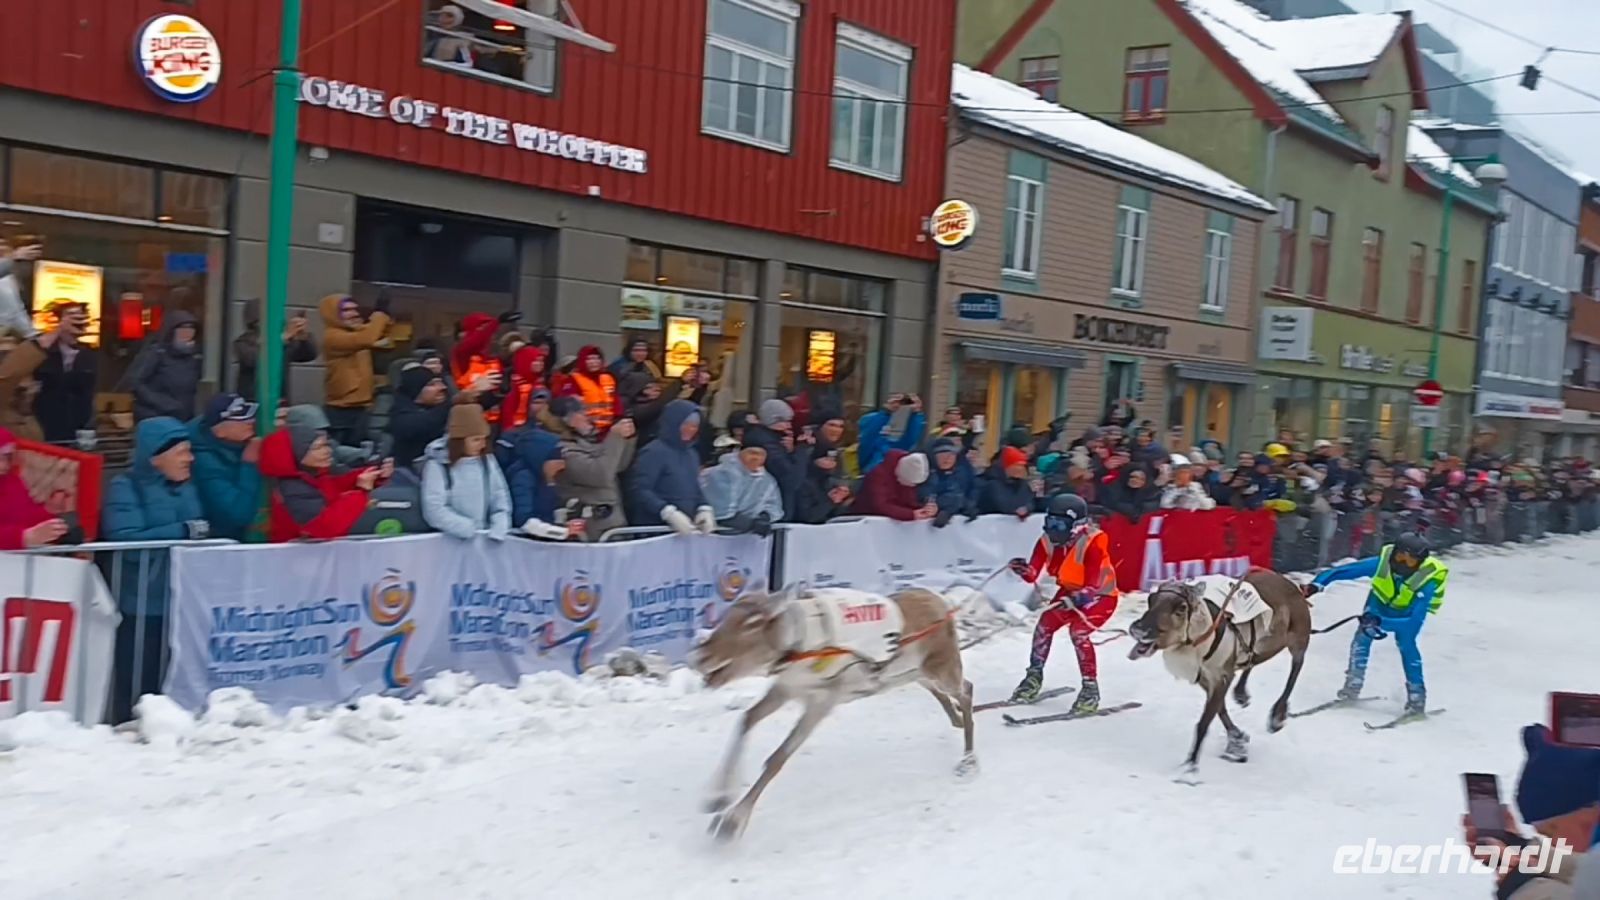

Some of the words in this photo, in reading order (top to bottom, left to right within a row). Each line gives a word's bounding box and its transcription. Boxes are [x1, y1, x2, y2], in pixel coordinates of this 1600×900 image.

[150, 36, 212, 52] BURGER
[147, 52, 211, 75] KING
[389, 95, 440, 128] OF
[442, 106, 513, 145] THE
[512, 122, 648, 174] WHOPPER
[451, 582, 556, 615] MidnightSun
[210, 598, 361, 634] MidnightSun
[450, 611, 530, 637] Marathon
[628, 605, 695, 631] Marathon
[208, 634, 330, 662] Marathon
